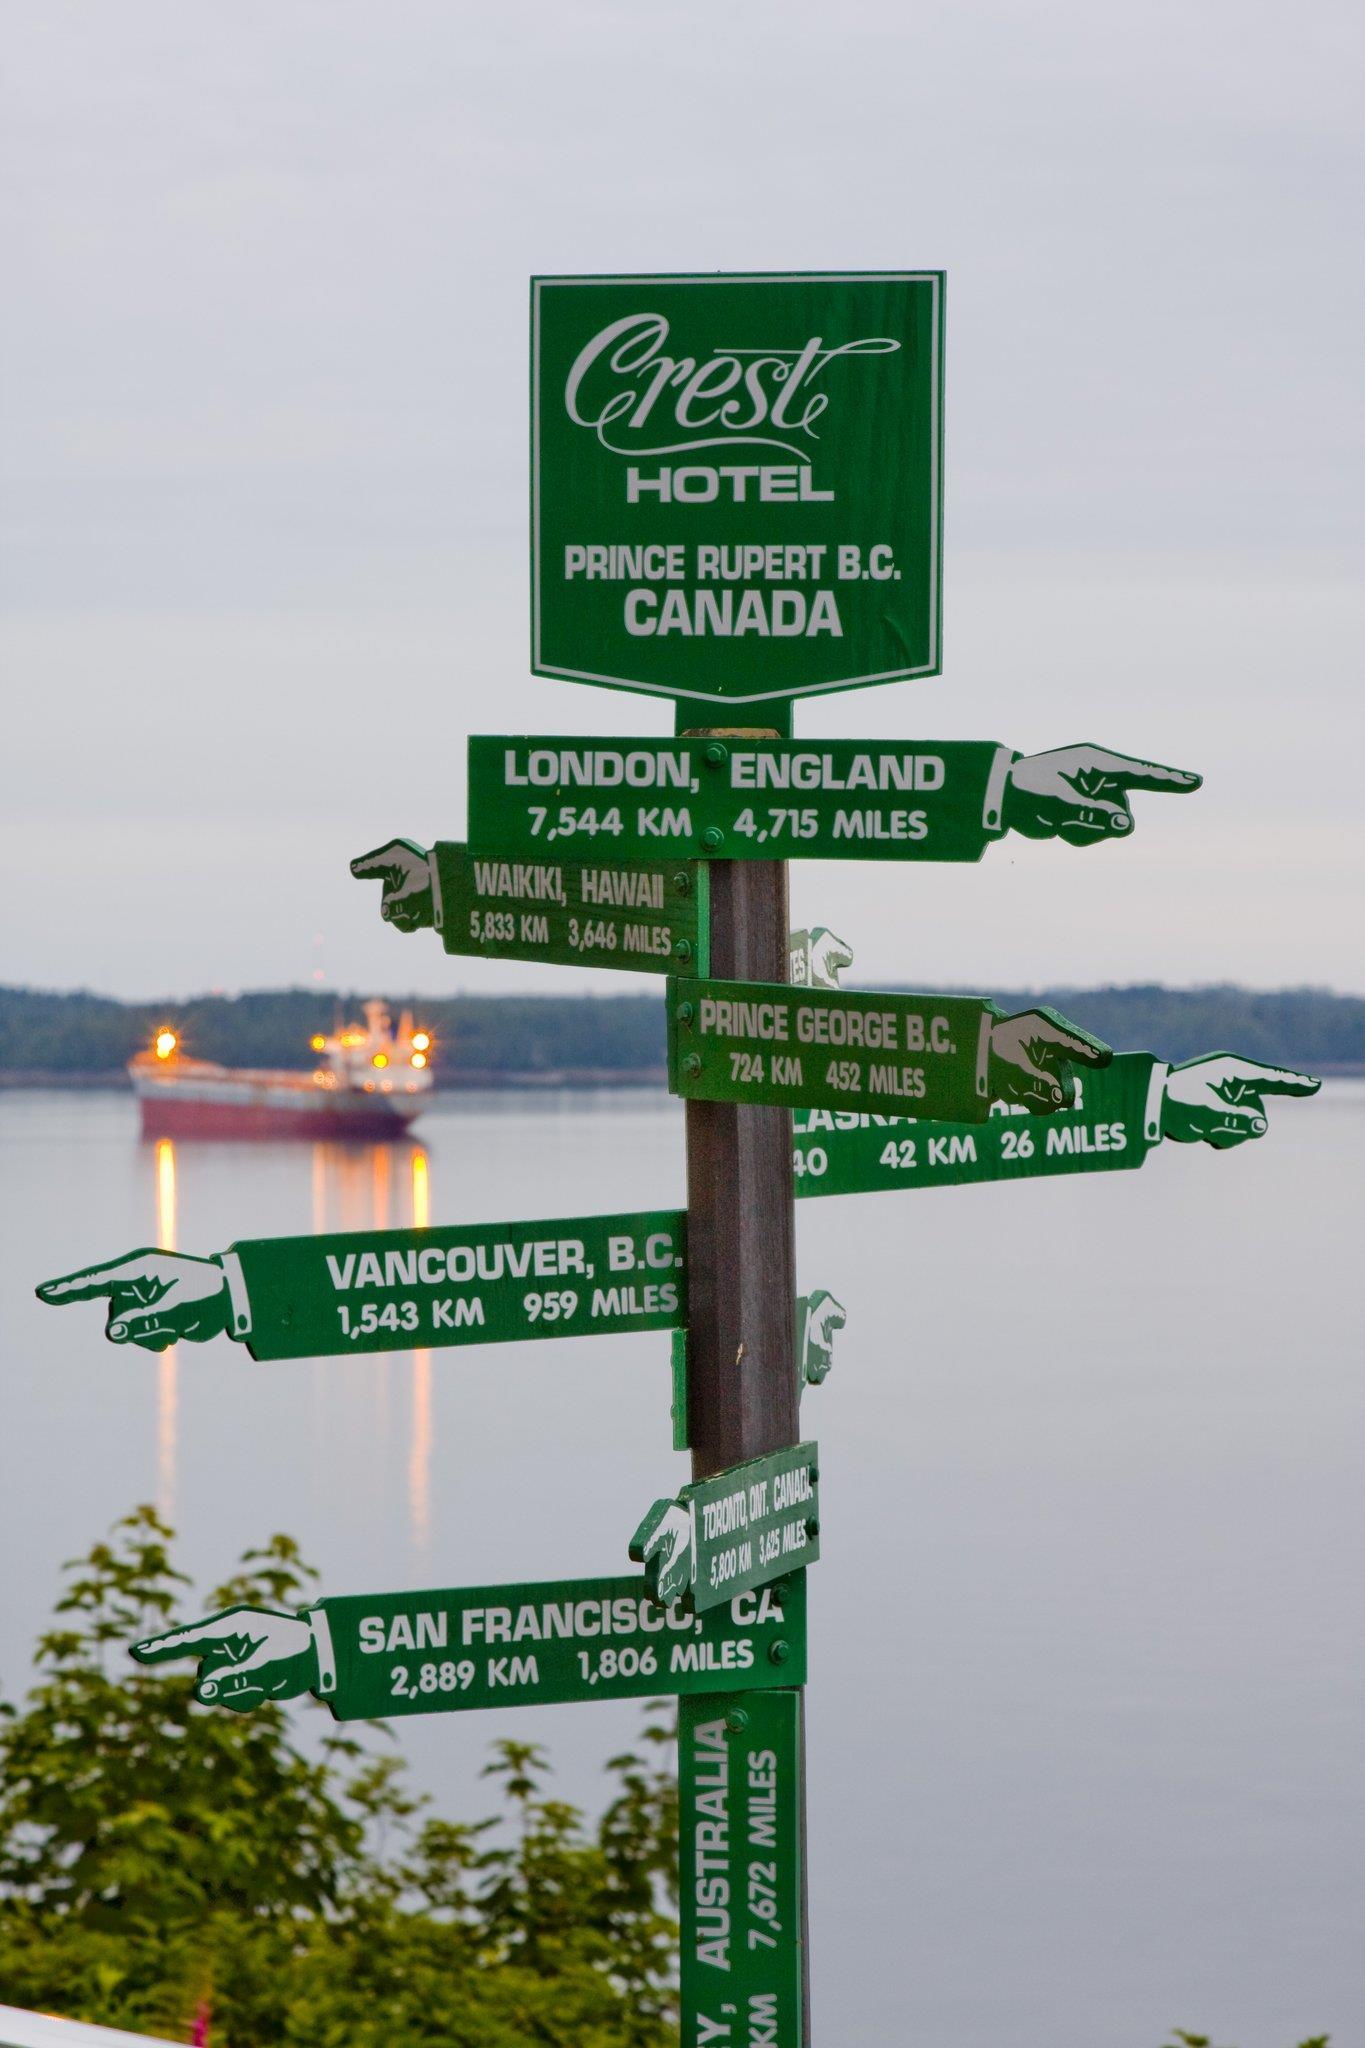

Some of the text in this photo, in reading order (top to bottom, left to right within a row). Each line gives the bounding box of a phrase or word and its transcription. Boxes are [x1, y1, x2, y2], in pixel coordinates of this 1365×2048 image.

[565, 313, 901, 462] Crest
[627, 466, 834, 503] HOTEL
[565, 544, 901, 580] PRINCE RUPERT B.C.
[625, 589, 843, 636] CANADA
[505, 750, 944, 793] LONDON, ENGLAND
[528, 807, 928, 842] 7,544 KM 4,715 MILES
[474, 862, 663, 908] WAIKIKI, HAWAII
[470, 911, 671, 956] 5,833 KM 3,646 MILES
[701, 999, 956, 1054] PRINCE GEORGE B.C.
[730, 1052, 764, 1083] 724
[772, 1056, 803, 1086] KM
[826, 1061, 861, 1091] 452
[869, 1064, 926, 1098] MILES
[880, 1140, 916, 1168] 42
[928, 1135, 977, 1165] KM
[1001, 1130, 1034, 1159] 26
[1046, 1123, 1126, 1155] MILES
[326, 1234, 682, 1290] VANCOUVER, B.C.
[337, 1283, 678, 1339] 1,543 KM 959 MILES
[703, 1490, 748, 1541] TORONTO,
[750, 1481, 767, 1521] ONT.
[710, 1519, 806, 1589] 5,800 KM 3,625 MILES
[359, 1612, 447, 1653] SAN
[731, 1587, 784, 1625] CA
[391, 1639, 754, 1699] 2,889 KM 1,806 MILES
[694, 1719, 730, 1970] AUSTRALIA
[748, 1750, 781, 2048] KM 7,672 MILES
